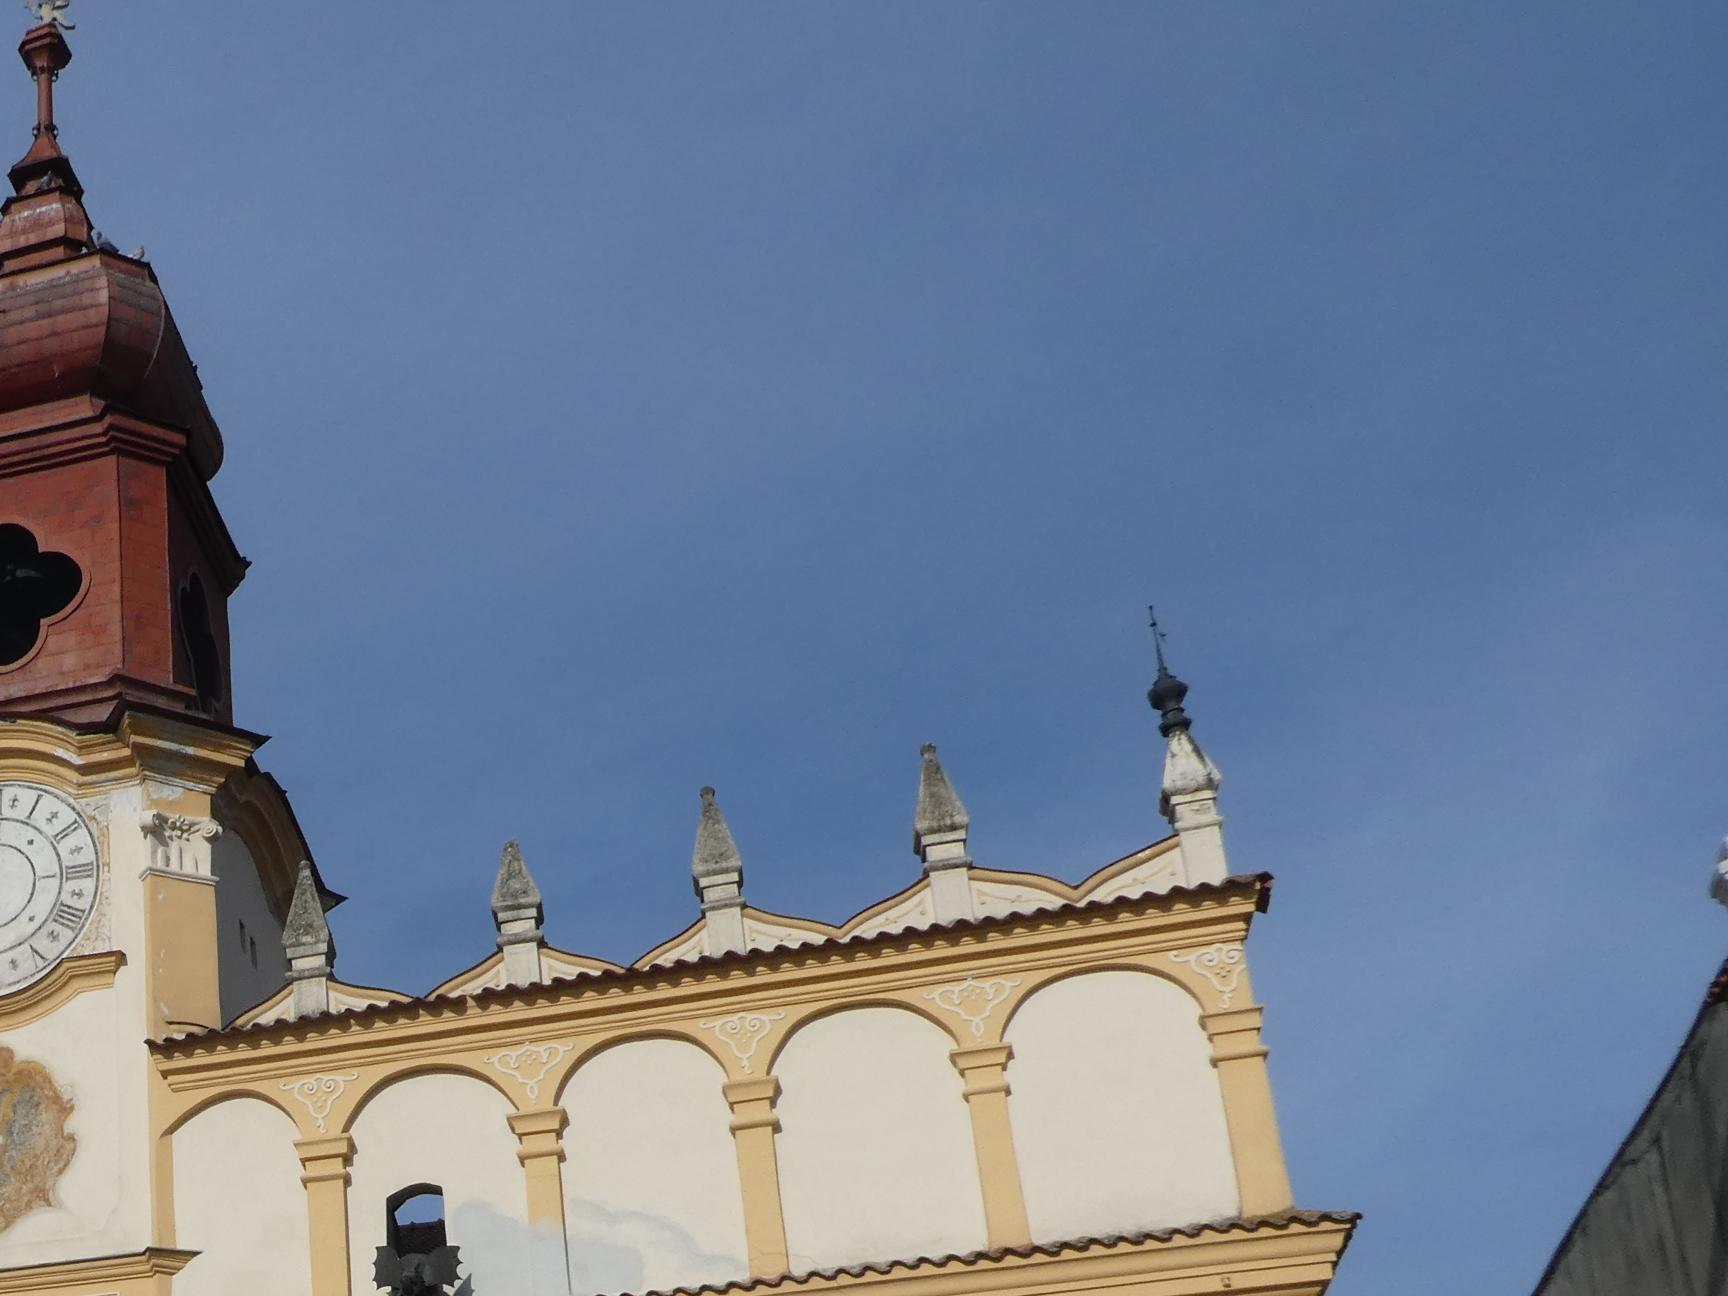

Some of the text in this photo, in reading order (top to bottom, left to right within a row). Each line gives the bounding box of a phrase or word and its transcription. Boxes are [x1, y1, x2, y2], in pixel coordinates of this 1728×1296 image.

[25, 794, 43, 819] I
[53, 819, 81, 844] II
[65, 861, 94, 881] III
[52, 903, 86, 931] IIII
[29, 944, 48, 969] V
